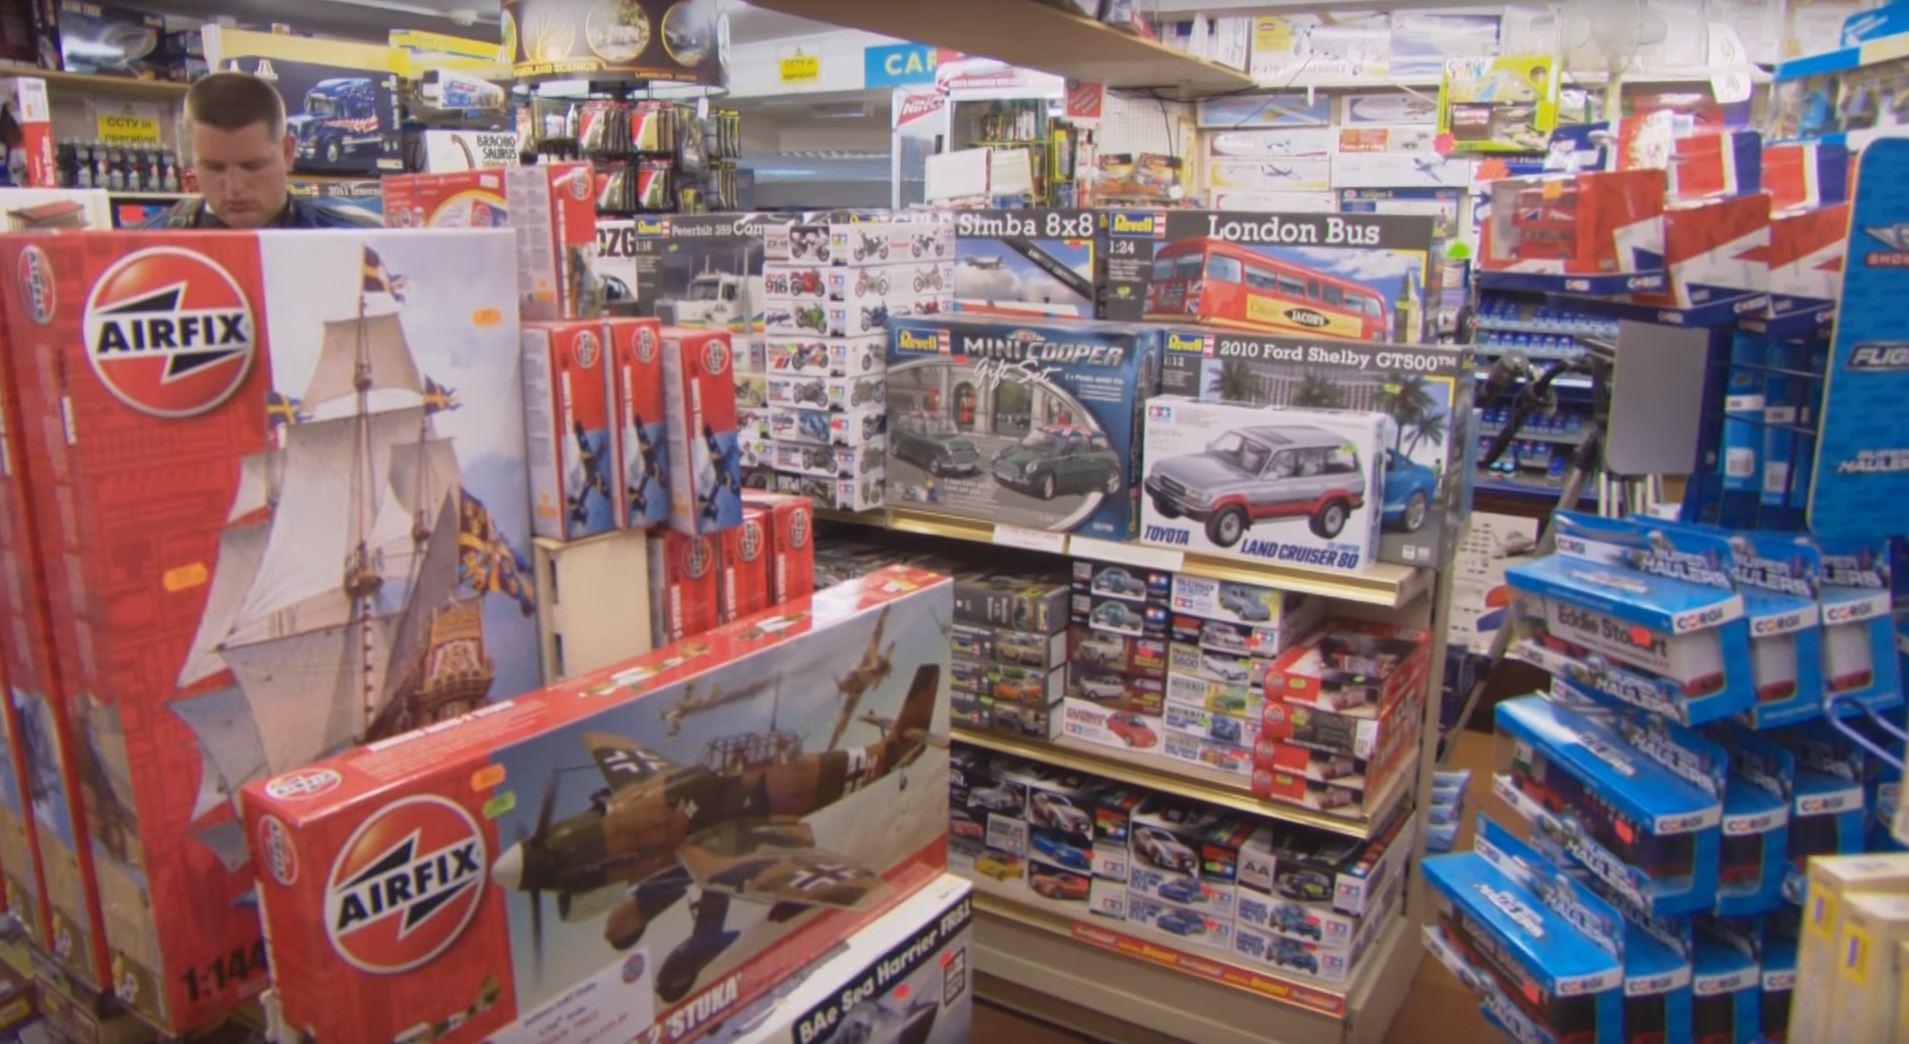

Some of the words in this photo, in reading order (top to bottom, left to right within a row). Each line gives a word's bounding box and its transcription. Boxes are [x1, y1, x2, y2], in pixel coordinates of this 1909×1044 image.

[107, 117, 139, 128] CCTV
[959, 213, 1037, 237] Simba
[1045, 213, 1094, 237] 8x8
[1114, 213, 1153, 234] Revell
[1207, 215, 1318, 243] London
[1325, 217, 1381, 246] Bus
[1108, 240, 1136, 255] 1:24
[765, 281, 788, 294] 916
[96, 313, 248, 354] AIRFIX
[898, 330, 938, 352] Revell
[962, 336, 1022, 360] MINI
[1026, 341, 1125, 367] COOPER
[1168, 335, 1202, 352] Revell
[1220, 340, 1259, 358] 2010
[1263, 344, 1302, 362] Ford
[1307, 347, 1371, 369] Shelby
[973, 358, 1012, 390] Gift
[1014, 360, 1063, 384] Set
[1143, 523, 1191, 547] TOYOTA
[1240, 537, 1277, 559] LAND
[1278, 543, 1335, 568] CRUISER
[1337, 552, 1359, 570] 80
[1640, 558, 1733, 589] HAULERS
[1732, 566, 1813, 598] AULERS
[1677, 607, 1724, 630] CORGI
[1827, 602, 1873, 621] CORGI
[1557, 604, 1599, 636] Eddie
[1601, 618, 1668, 658] Stort
[1755, 614, 1800, 634] CORGI
[1801, 797, 1846, 813] CORGI
[1658, 816, 1704, 833] CORGI
[1728, 816, 1772, 833] CORGI
[336, 839, 481, 932] AIRFIX
[797, 1006, 840, 1044] BAe
[841, 980, 876, 1011] Sea
[876, 927, 938, 985] Harrier
[1629, 976, 1673, 993] CORGI
[1700, 974, 1741, 992] CORGI
